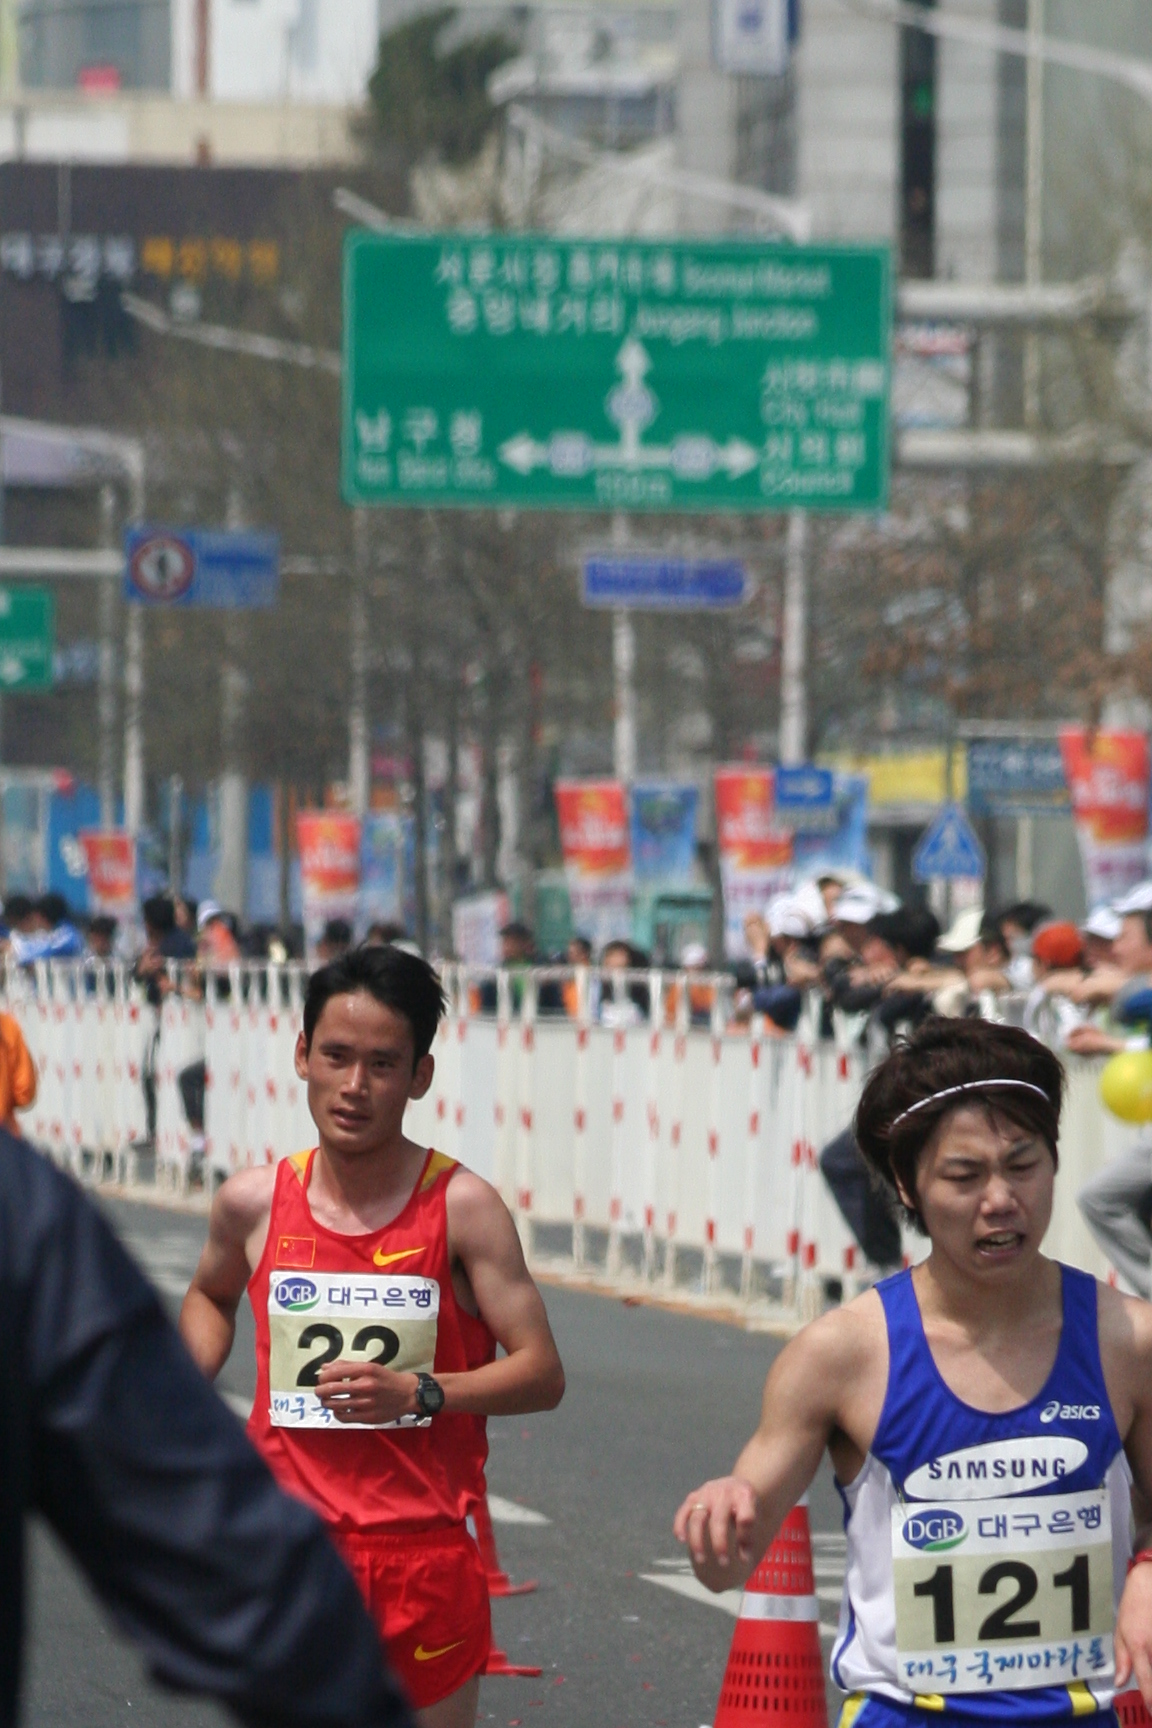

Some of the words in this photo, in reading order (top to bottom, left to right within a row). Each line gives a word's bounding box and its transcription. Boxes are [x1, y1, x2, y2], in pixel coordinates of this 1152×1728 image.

[278, 1284, 312, 1302] DGB
[328, 1287, 431, 1308] 대구은행
[296, 1323, 400, 1387] 22
[1060, 1404, 1101, 1420] asics
[928, 1456, 1068, 1480] SAMSUNG
[907, 1517, 959, 1542] DGB
[978, 1504, 1102, 1539] 대구은행
[913, 1553, 1091, 1644] 121
